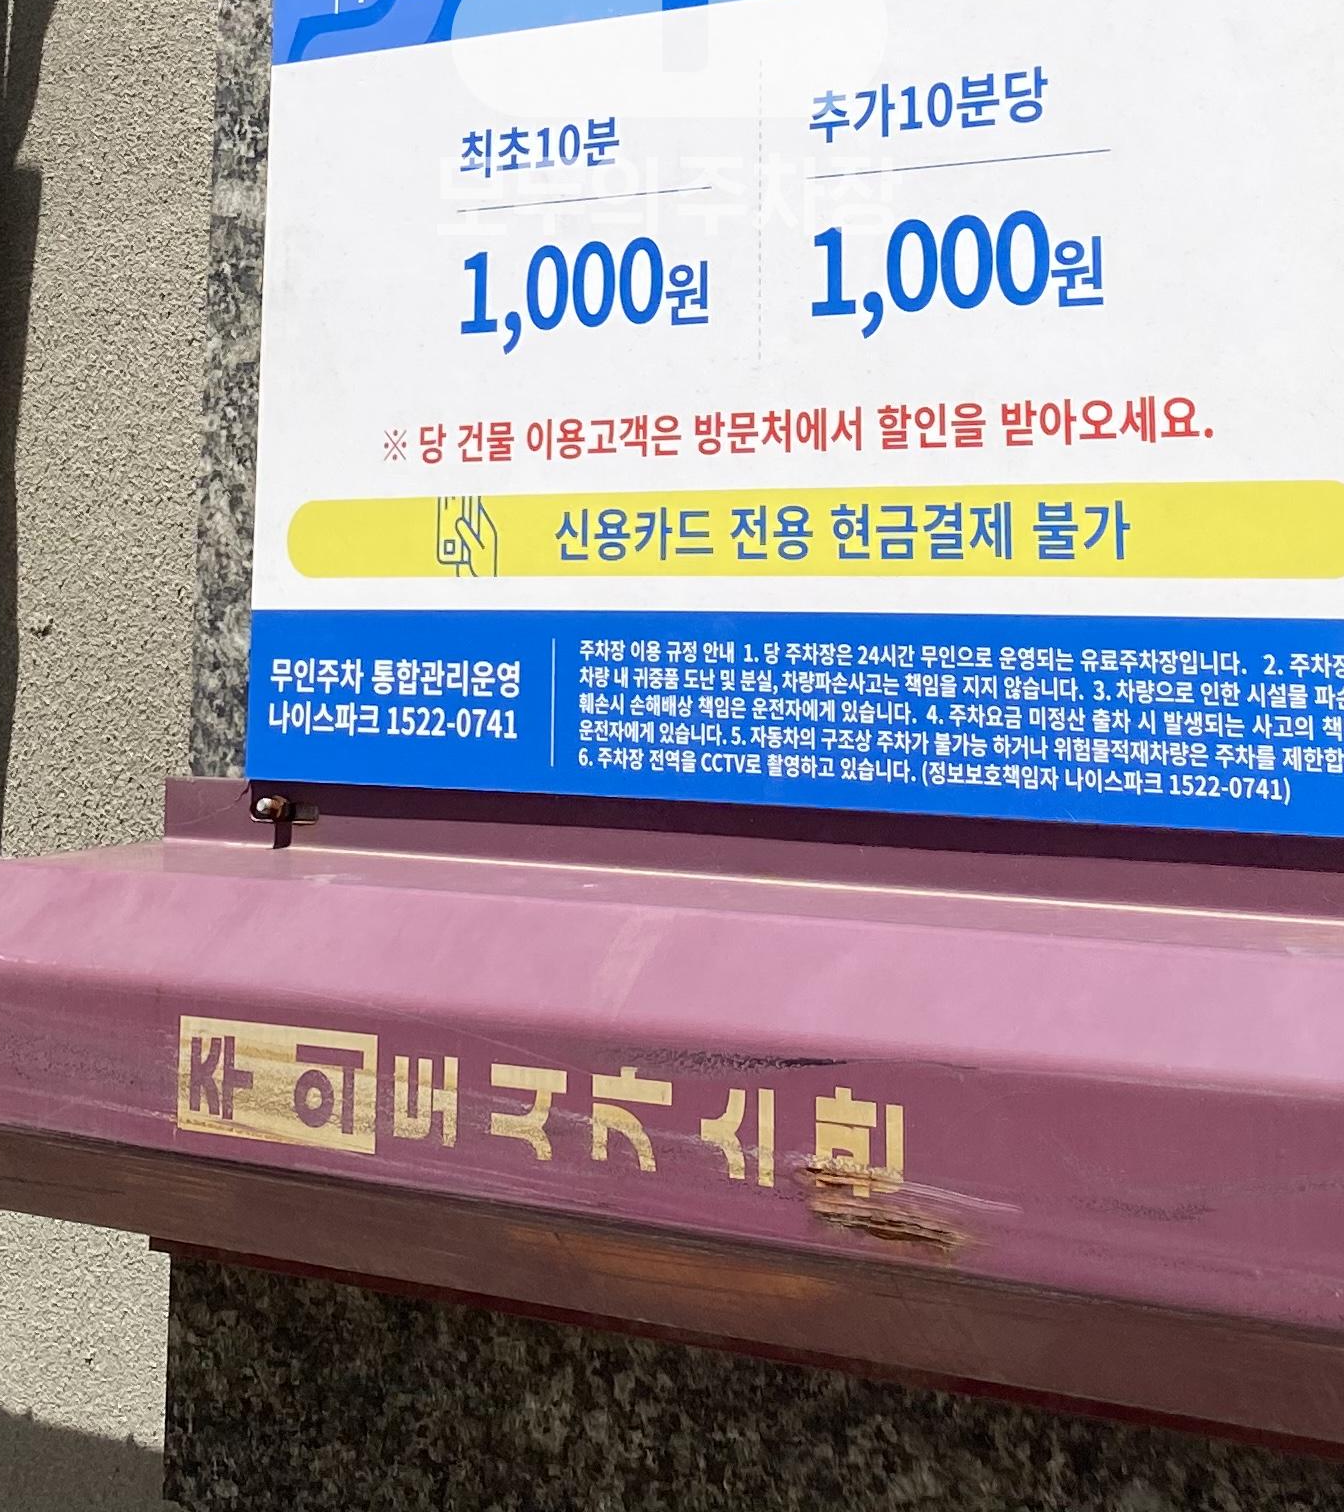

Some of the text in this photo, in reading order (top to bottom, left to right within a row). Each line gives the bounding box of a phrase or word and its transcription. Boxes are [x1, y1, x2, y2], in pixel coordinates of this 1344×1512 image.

[809, 66, 1049, 144] 추가10분당
[460, 117, 620, 178] 최초10분
[460, 236, 709, 355] 1,000원
[811, 210, 1105, 340] 1,000원
[419, 423, 446, 464] 당
[457, 420, 515, 463] 건물
[526, 413, 682, 462] 이용고객은
[694, 407, 862, 456] 방문처에서
[877, 401, 987, 450] 할인을
[1001, 395, 1214, 447] 받아오세요.
[556, 500, 1131, 562] 신용카드 전용 현금결제 불가
[270, 658, 521, 698] 무인주차 통합관리운영
[579, 639, 626, 662] 주차장
[630, 640, 661, 662] 이용
[666, 641, 698, 664] 규정
[703, 641, 735, 664] 안내
[743, 643, 759, 664] 1.
[763, 642, 780, 665] 당
[785, 642, 853, 666] 주차장은
[857, 644, 915, 668] 24시간
[920, 645, 993, 670] 무인으로
[998, 646, 1074, 672] 운영되는
[1080, 648, 1248, 677] 유료주차장입니다.
[1262, 653, 1284, 676] 2.
[578, 693, 625, 715] 훼손시
[629, 694, 693, 717] 손해배상
[698, 695, 746, 720] 책임은
[751, 696, 836, 723] 운전자에게
[841, 699, 917, 725] 있습니다.
[926, 704, 944, 725] 4.
[948, 704, 1023, 730] 주차요금
[1028, 706, 1086, 733] 미정산
[1092, 708, 1131, 734] 출차
[1137, 710, 1156, 735] 시
[1163, 710, 1245, 738] 발생되는
[1251, 713, 1314, 740] 사고의
[579, 666, 610, 688] 차량
[613, 666, 629, 689] 내
[632, 667, 680, 690] 귀중품
[683, 668, 715, 691] 도난
[720, 668, 736, 692] 및
[740, 670, 778, 695] 분실,
[782, 670, 900, 696] 차량파손사고는
[904, 672, 957, 698] 책임을
[962, 674, 998, 700] 지지
[1003, 675, 1084, 702] 않습니다.
[1092, 679, 1111, 701] 3.
[1116, 680, 1195, 705] 차량으로
[1200, 682, 1241, 708] 인한
[1246, 683, 1309, 710] 시설물
[268, 700, 518, 741] 나이스파크 1522-0741
[578, 720, 654, 744] 운전자에게
[659, 721, 726, 746] 있습니다.
[731, 727, 746, 746] 5.
[750, 725, 816, 750] 자동차의
[820, 728, 872, 753] 구조상
[876, 730, 929, 755] 주차가
[933, 731, 987, 758] 불가능
[993, 734, 1048, 760] 하거나
[1053, 735, 1209, 768] 위험물적재차량은
[1214, 744, 1276, 771] 주차를
[578, 747, 1292, 806] 6. 주차장 전역을 CCTV로 촬영하고 있습니다. (정보보호책임자 나이스파크 1522-0741)
